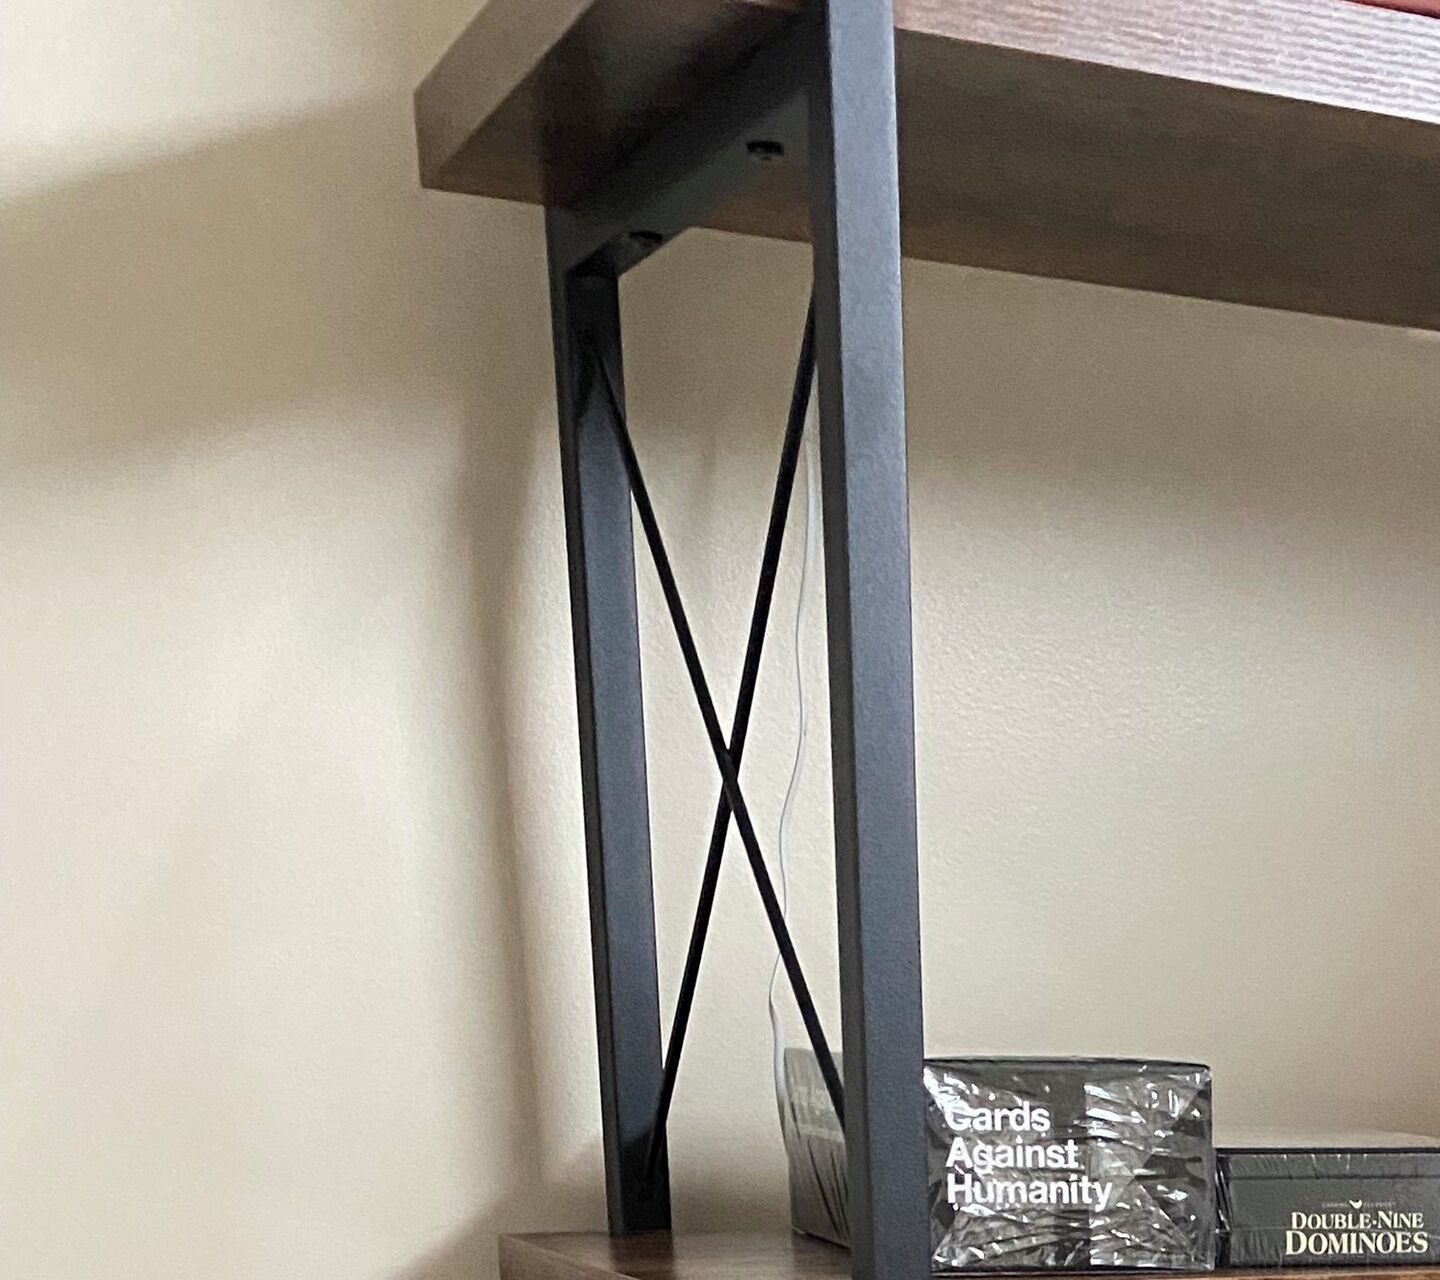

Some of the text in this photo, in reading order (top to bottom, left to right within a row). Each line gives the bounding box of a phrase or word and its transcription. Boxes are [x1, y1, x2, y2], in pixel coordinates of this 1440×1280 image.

[947, 1100, 1050, 1132] Cards
[945, 1137, 1080, 1176] Against
[946, 1173, 1113, 1213] Humanity
[1285, 1230, 1430, 1256] DOMINOES
